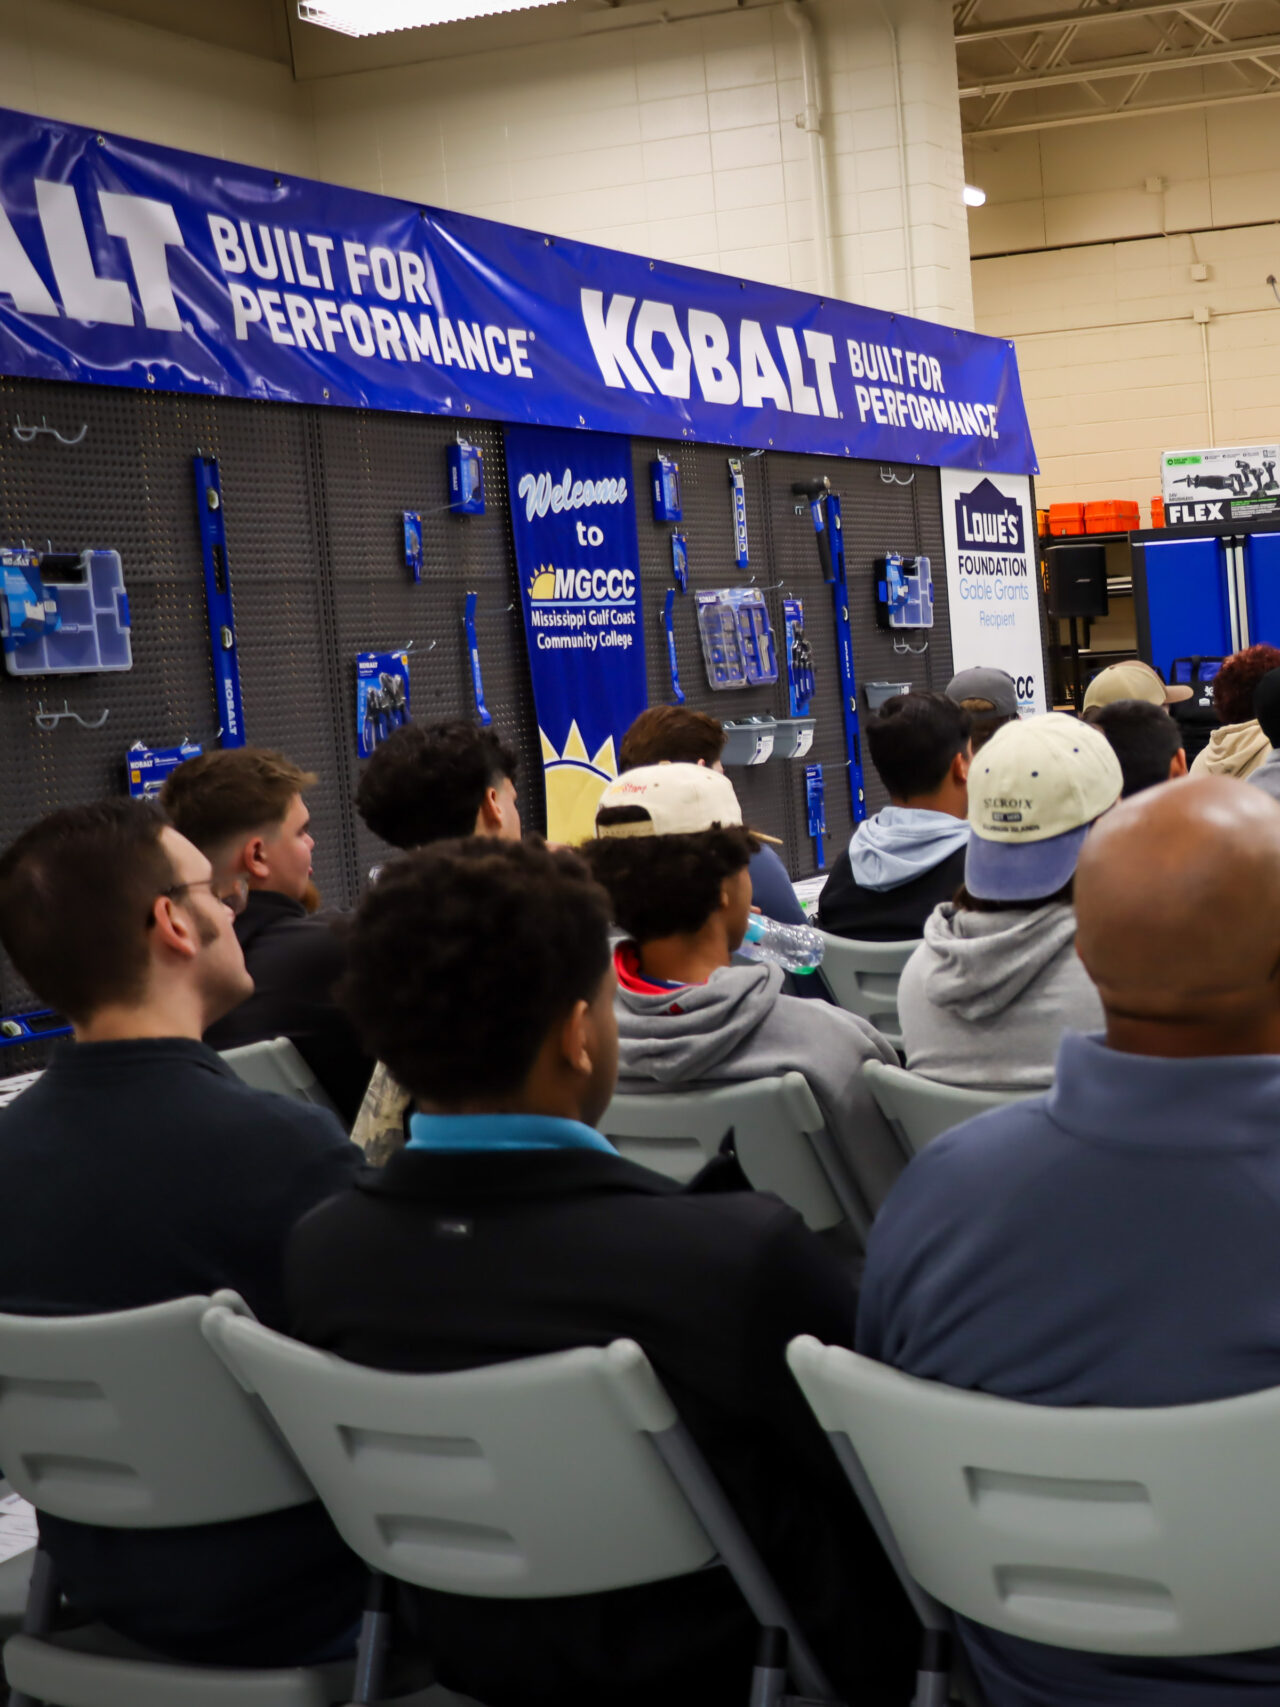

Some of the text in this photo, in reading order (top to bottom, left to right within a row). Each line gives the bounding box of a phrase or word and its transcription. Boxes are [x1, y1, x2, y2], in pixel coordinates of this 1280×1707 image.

[207, 212, 432, 305] BUILT FOR
[228, 282, 534, 379] PERFORMANCE
[580, 288, 838, 419] KOBALT
[847, 339, 945, 393] BUILT FOR
[855, 385, 999, 439] PERFORMANCE
[518, 468, 628, 522] Welcome
[962, 504, 1019, 545] LOWE'S
[1169, 502, 1224, 523] FLEX
[576, 521, 604, 546] to
[958, 555, 1027, 577] FOUNDATION
[554, 568, 636, 599] MGCCC
[959, 578, 1029, 601] Gable Grants
[531, 609, 636, 630] Mississippi Gulf Coast
[979, 610, 1015, 629] Recipient
[537, 630, 633, 651] Community College
[224, 679, 238, 736] KOBALT
[130, 760, 154, 769] KOBALT
